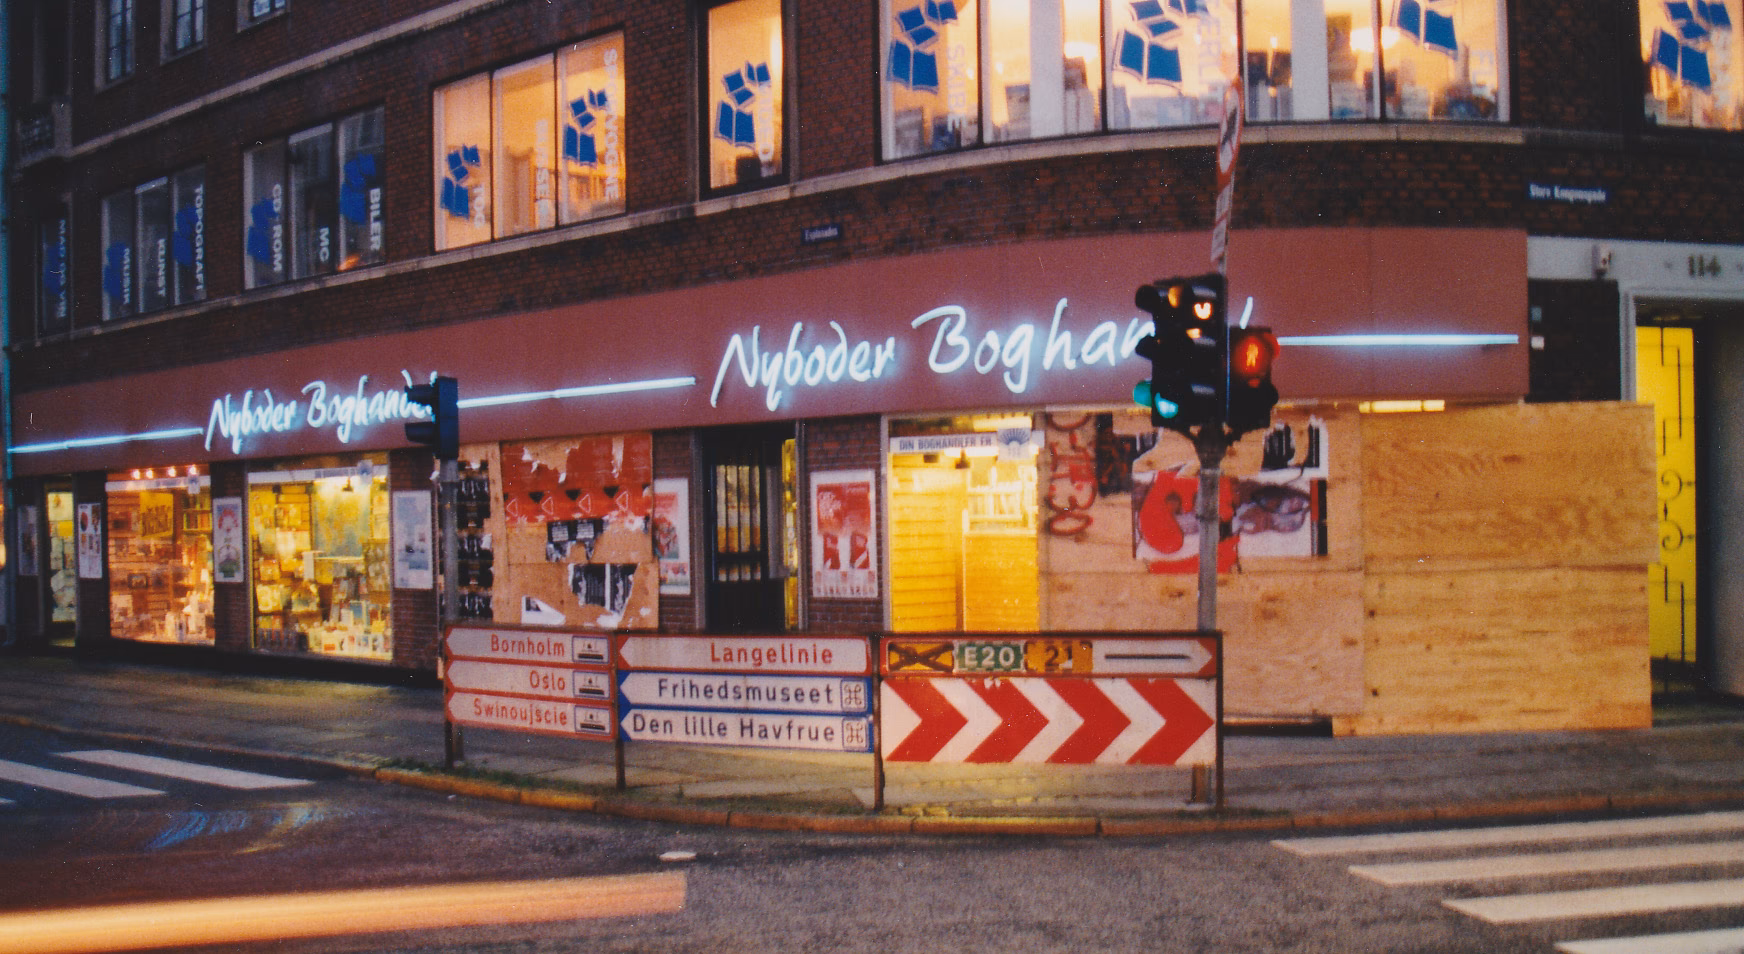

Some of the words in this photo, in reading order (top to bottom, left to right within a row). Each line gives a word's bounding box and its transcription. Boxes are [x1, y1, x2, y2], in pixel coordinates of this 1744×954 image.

[369, 187, 382, 251] BILER
[194, 184, 204, 291] TOPOGRAFI
[319, 226, 330, 263] MC
[122, 247, 132, 305] MUSIK
[157, 237, 167, 298] KUNST
[1687, 253, 1722, 278] 114
[711, 320, 896, 412] Nyboder
[204, 387, 297, 455] Nyboder
[899, 439, 915, 451] DIN
[490, 633, 565, 657] Bornholm
[710, 641, 833, 667] Langelinie
[963, 645, 1015, 668] E20
[529, 669, 566, 691] Oslo
[657, 677, 833, 705] Frihedsmuseet
[632, 713, 674, 735] Den
[684, 715, 728, 737] lille
[739, 717, 835, 742] Havfrue
